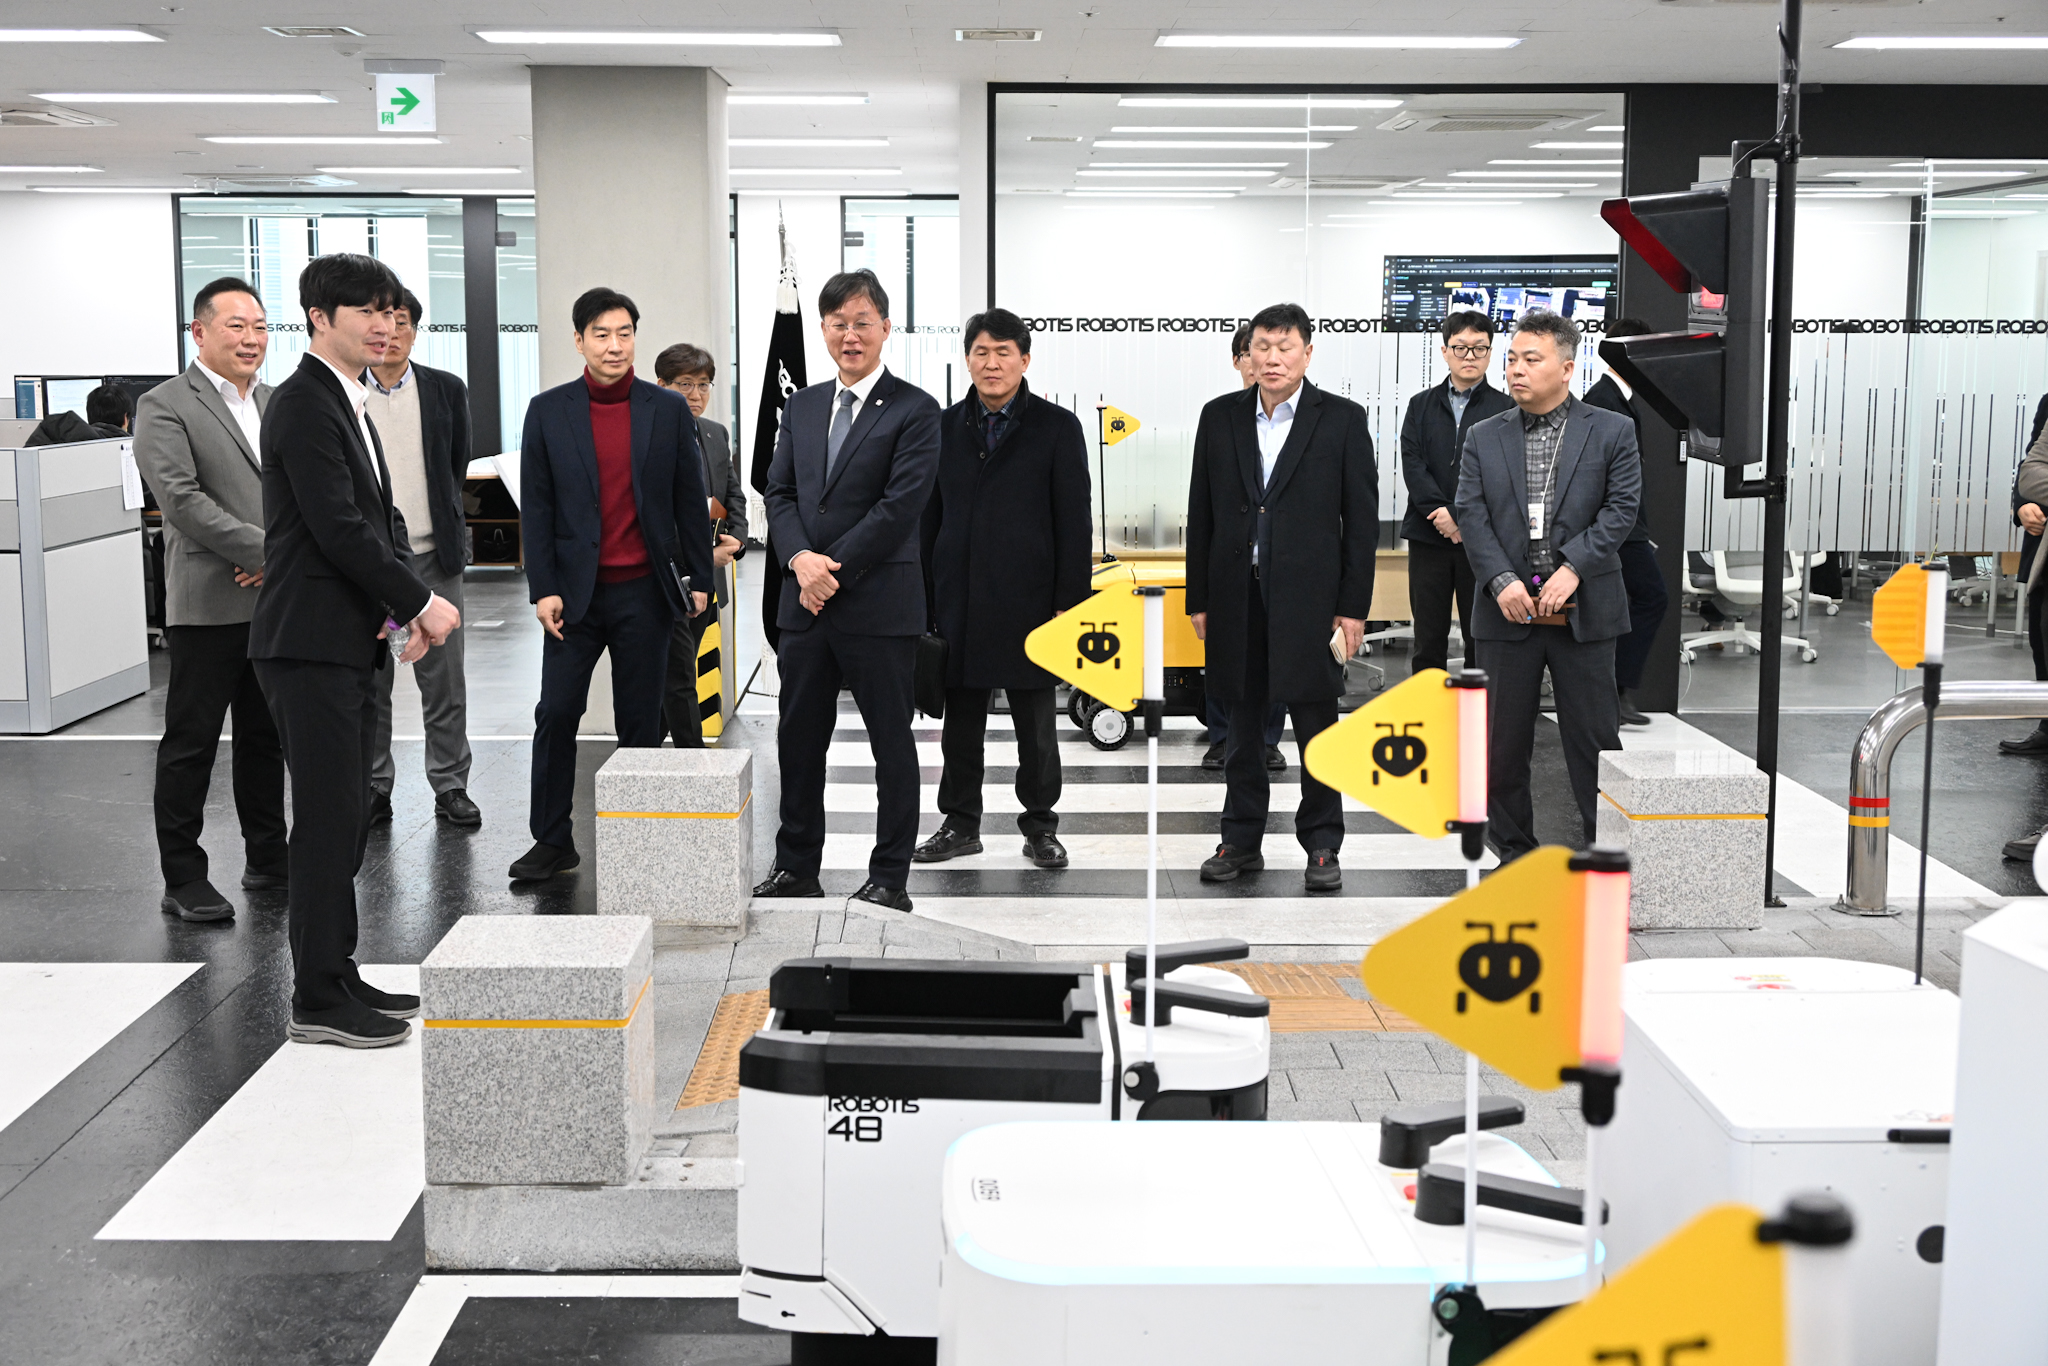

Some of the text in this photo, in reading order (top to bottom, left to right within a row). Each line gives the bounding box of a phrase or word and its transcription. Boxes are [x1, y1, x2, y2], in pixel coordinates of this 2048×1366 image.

[276, 323, 305, 332] ROBO
[891, 325, 936, 334] ROOTIS
[1022, 318, 1073, 333] BOTIS
[1076, 318, 1154, 333] ROBOTIS
[1157, 318, 1235, 333] ROBOTIS
[1318, 318, 1381, 333] ROBOT
[1916, 319, 1993, 333] ROBOTIS
[1997, 319, 2048, 333] ROBO
[828, 1098, 920, 1113] ROBOTIS
[828, 1116, 882, 1142] 48
